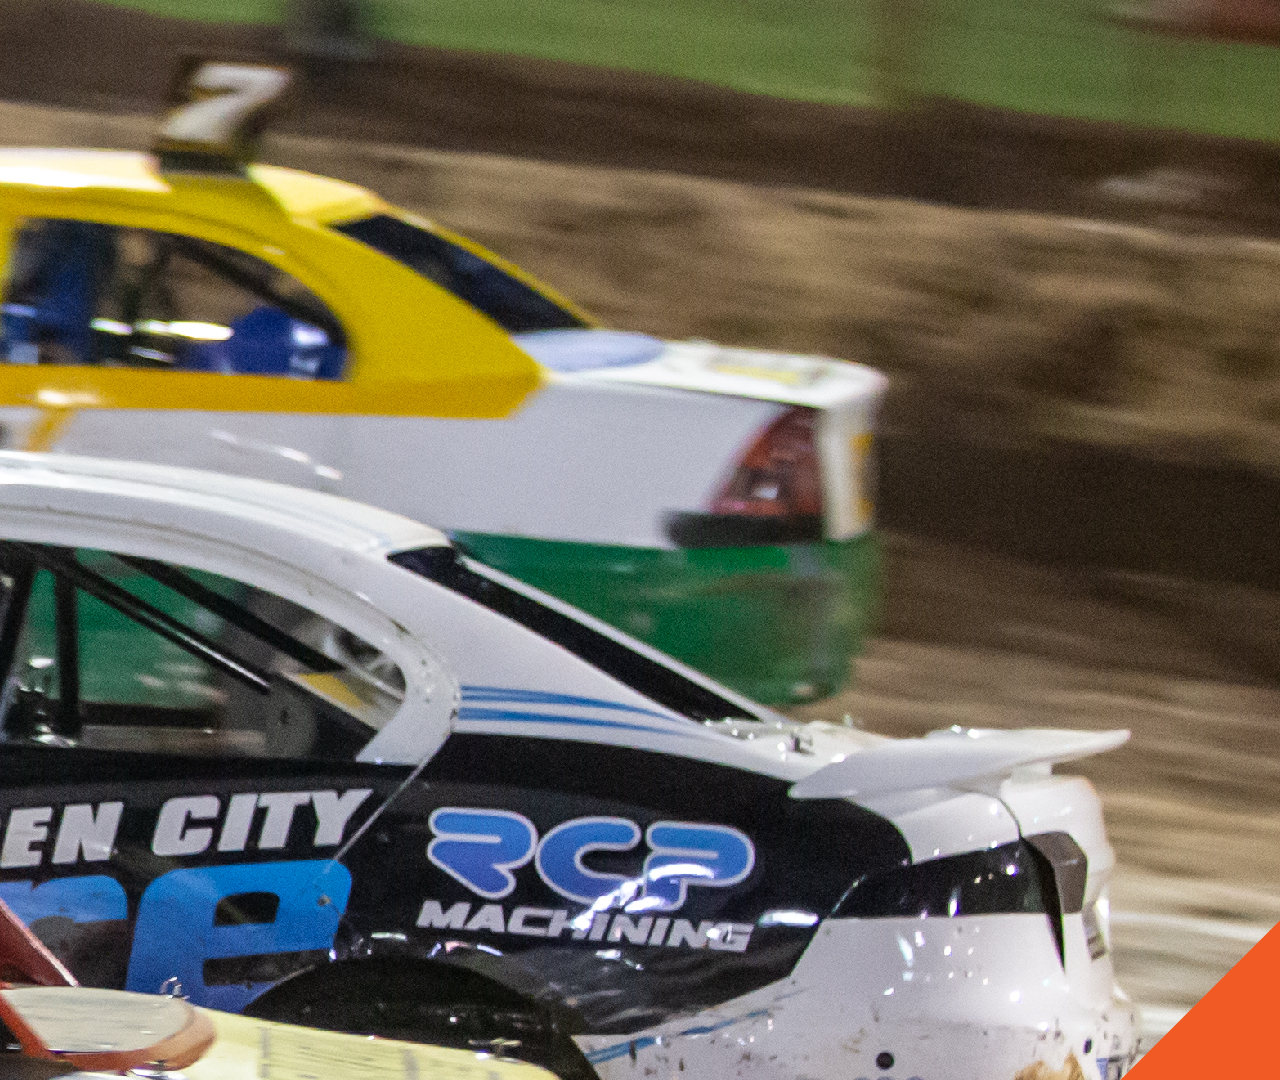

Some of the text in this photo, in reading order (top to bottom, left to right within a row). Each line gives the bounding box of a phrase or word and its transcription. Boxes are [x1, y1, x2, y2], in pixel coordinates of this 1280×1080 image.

[161, 62, 291, 144] 7
[151, 788, 374, 857] CITY
[427, 806, 756, 911] RCP
[416, 900, 755, 953] MACHINING
